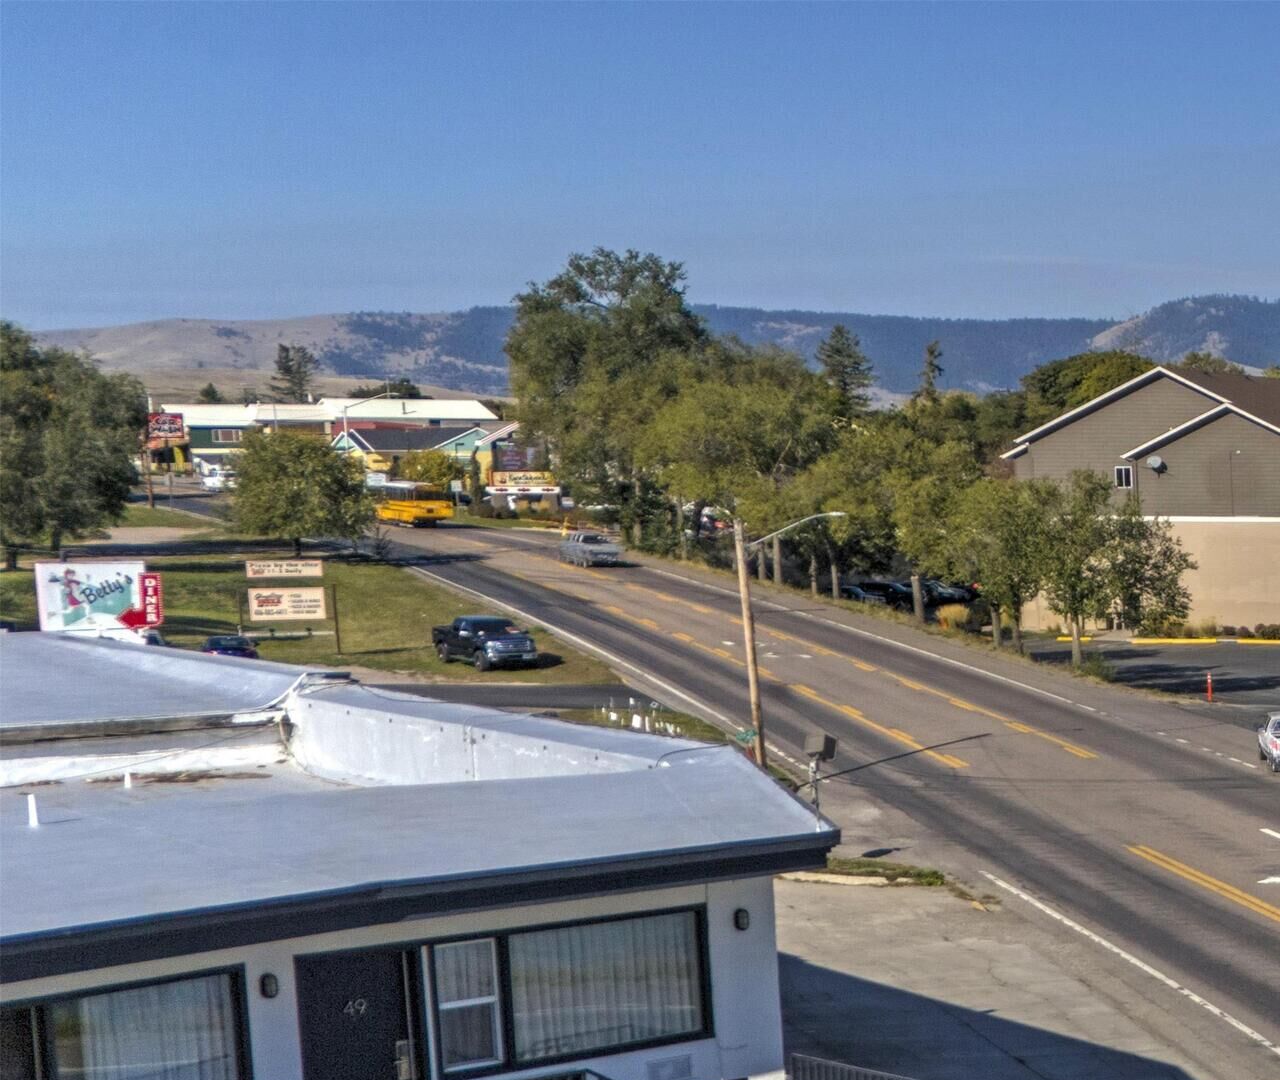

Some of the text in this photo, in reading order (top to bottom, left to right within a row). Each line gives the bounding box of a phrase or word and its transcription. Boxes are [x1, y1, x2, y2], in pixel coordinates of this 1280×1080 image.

[80, 571, 133, 605] Betty's
[144, 577, 158, 624] DINER
[343, 998, 367, 1015] 49
